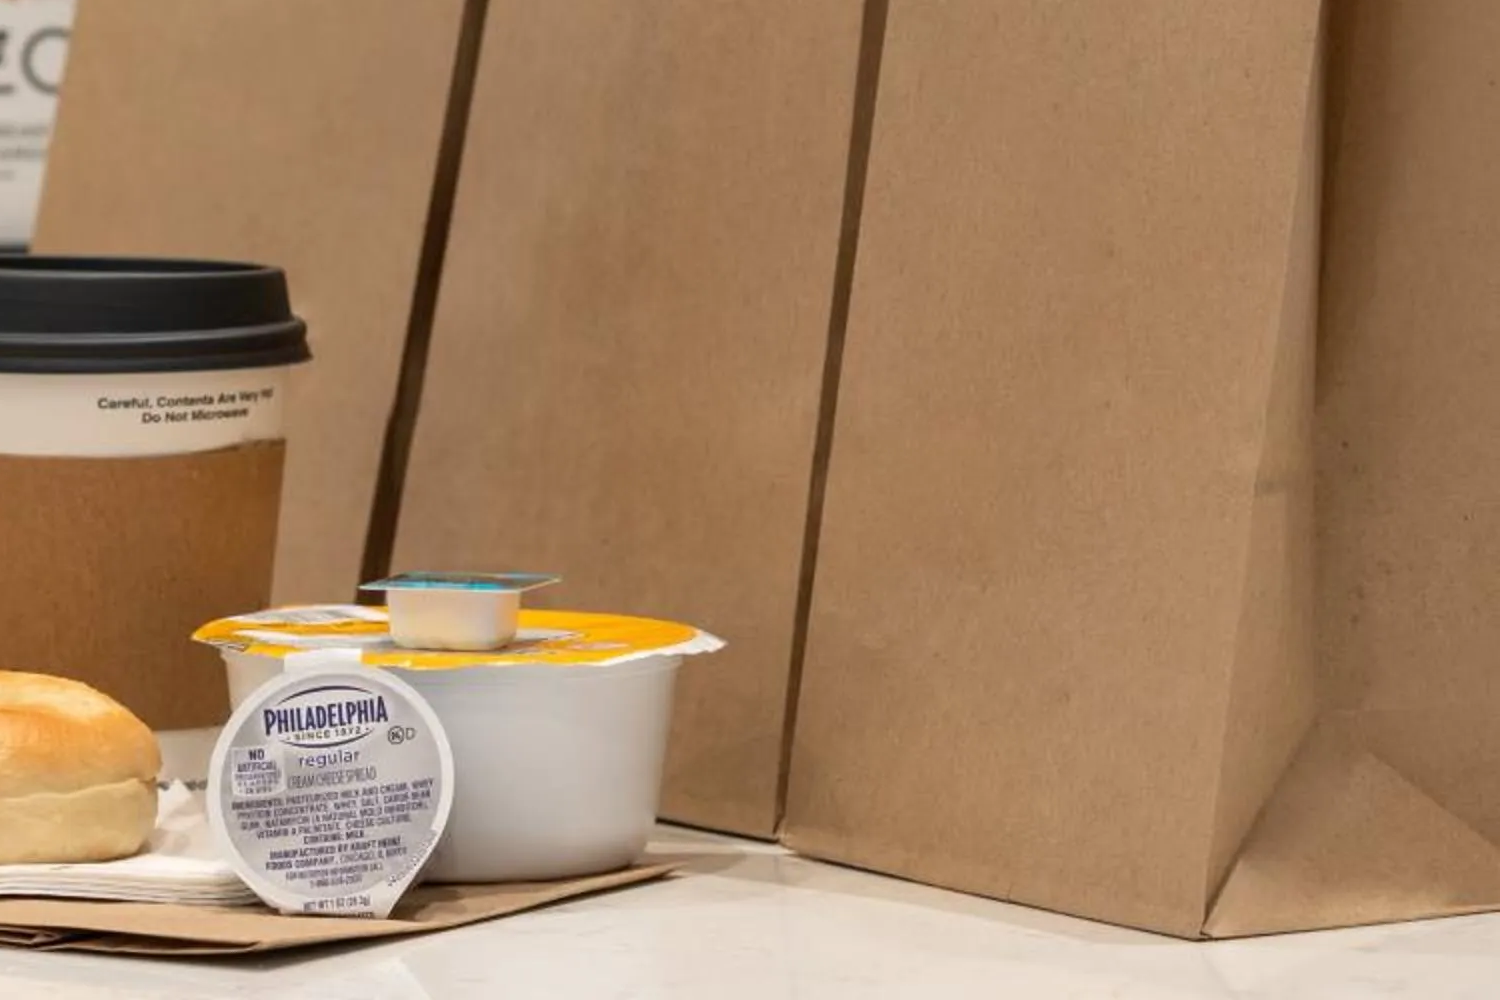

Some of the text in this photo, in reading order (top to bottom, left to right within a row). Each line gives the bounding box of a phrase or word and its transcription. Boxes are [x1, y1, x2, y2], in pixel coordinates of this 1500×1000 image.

[217, 392, 236, 404] Are
[142, 412, 161, 423] Do
[165, 411, 187, 422] Not
[263, 696, 389, 736] PHILADELPHIA
[295, 729, 330, 740] SINCE
[248, 748, 265, 761] NO
[299, 750, 360, 768] regular
